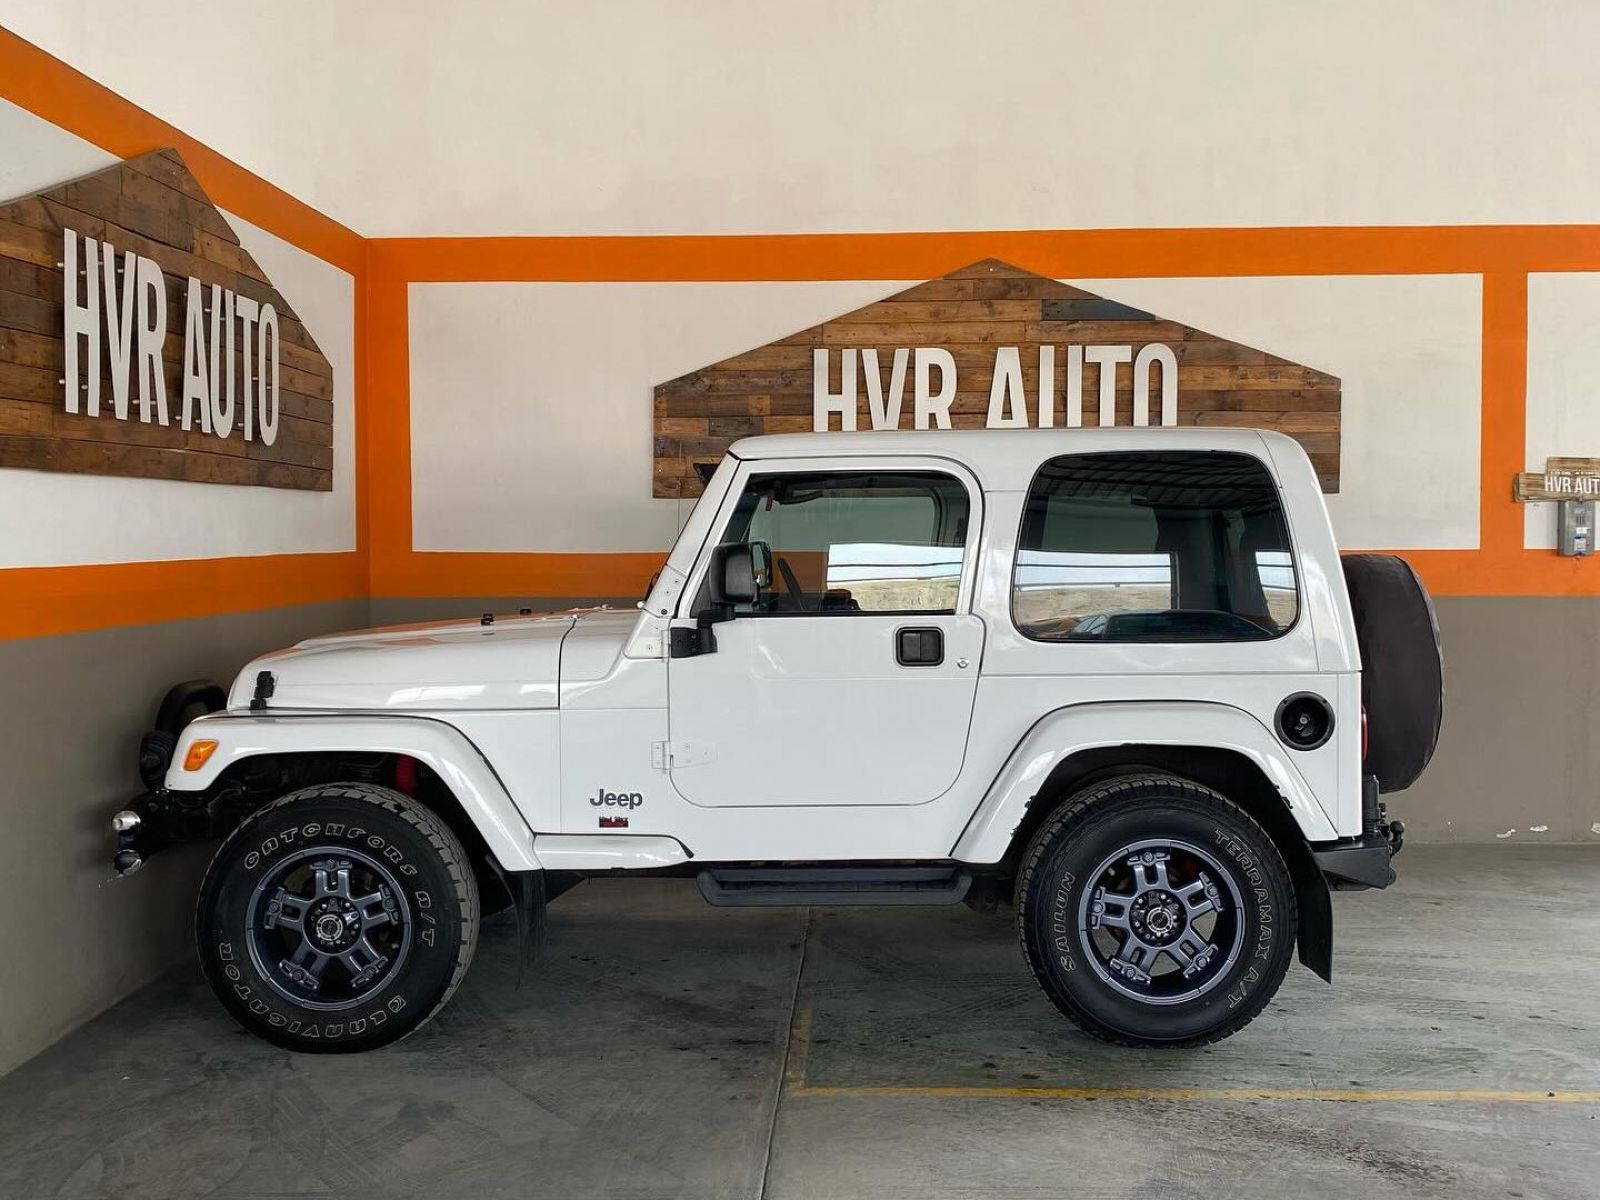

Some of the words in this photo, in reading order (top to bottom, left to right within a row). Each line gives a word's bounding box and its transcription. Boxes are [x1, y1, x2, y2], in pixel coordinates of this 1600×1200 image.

[64, 228, 170, 426] HVR
[181, 275, 280, 446] AUTO
[813, 347, 958, 431] HVR
[985, 343, 1179, 428] AUTO
[1544, 475, 1572, 492] HVR
[589, 788, 643, 809] Jeep
[415, 890, 436, 947] A/T
[1054, 871, 1076, 972] SAILUN
[1214, 829, 1272, 960] TERRAMAX
[1227, 966, 1261, 1009] A/T
